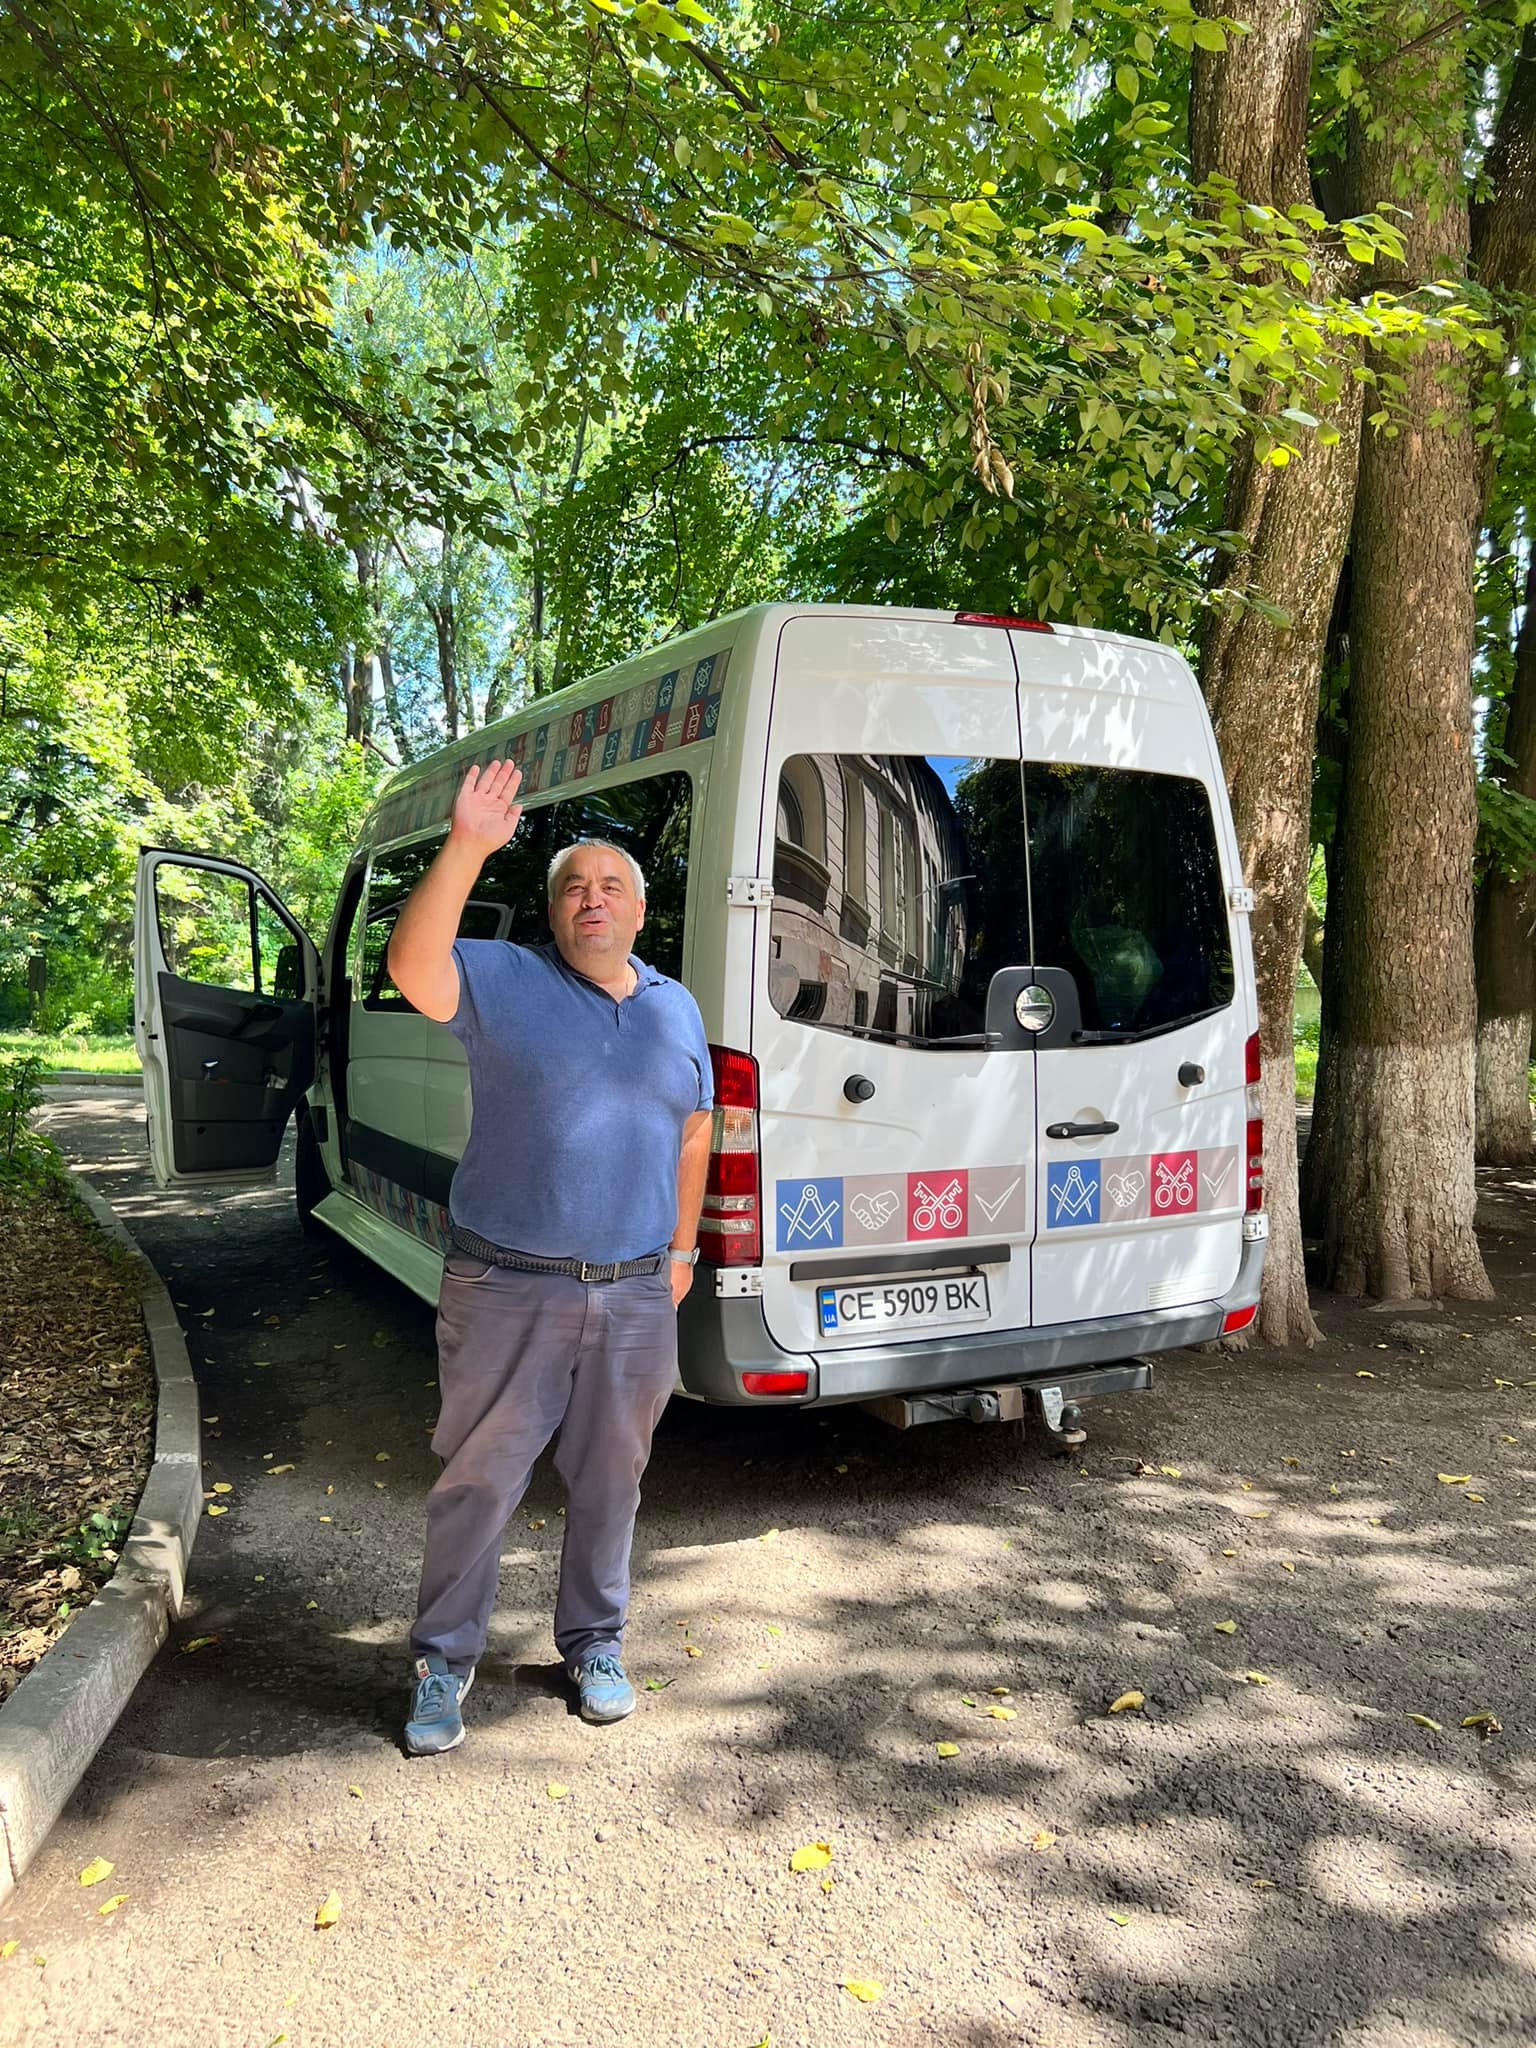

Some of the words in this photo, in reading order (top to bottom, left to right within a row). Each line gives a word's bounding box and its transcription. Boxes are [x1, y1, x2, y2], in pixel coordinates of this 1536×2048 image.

[838, 1291, 877, 1321] CE
[883, 1286, 938, 1317] 5909
[944, 1281, 981, 1311] BK
[825, 1314, 837, 1324] UA
